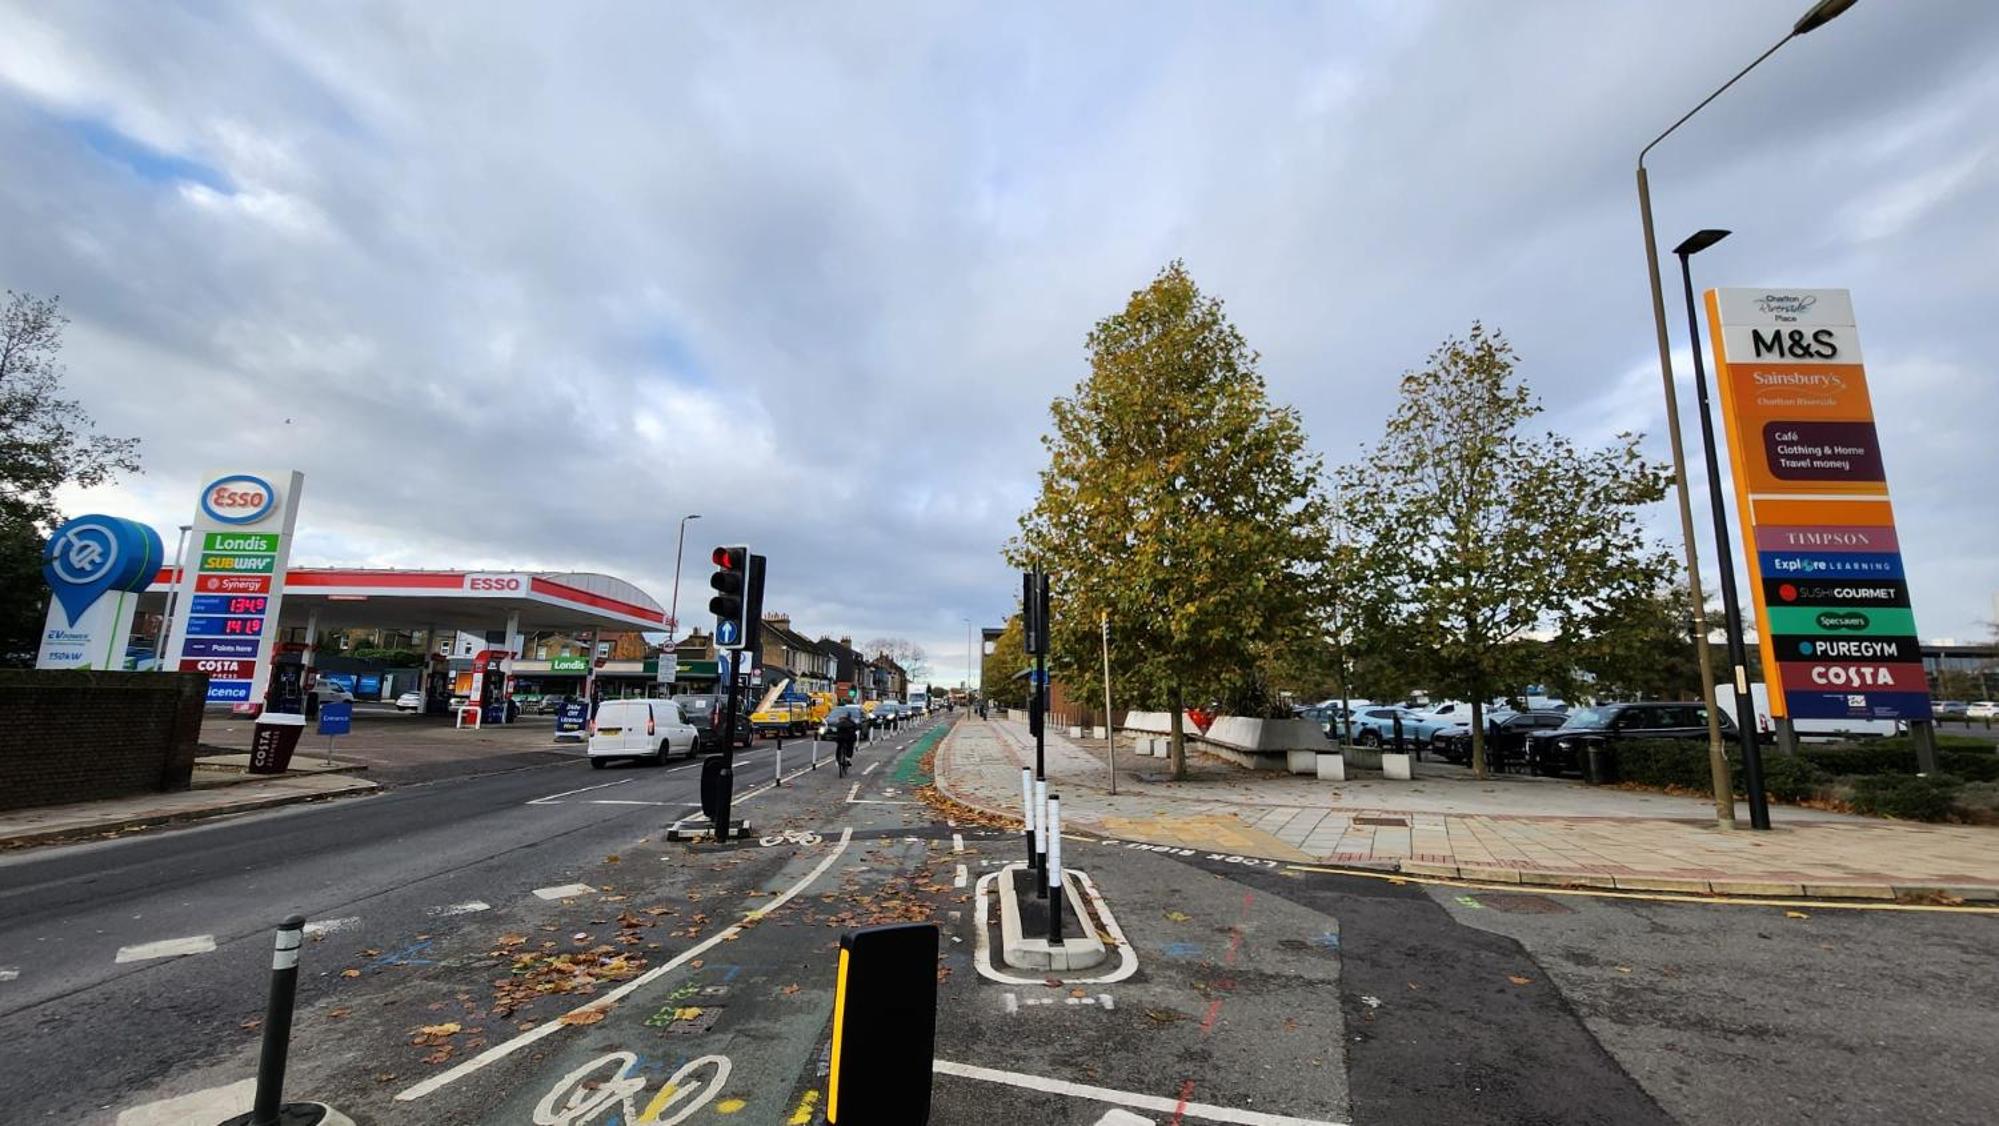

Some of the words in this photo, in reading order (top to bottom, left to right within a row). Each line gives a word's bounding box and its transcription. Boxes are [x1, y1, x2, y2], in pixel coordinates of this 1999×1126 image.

[1751, 329, 1838, 359] M&S
[1753, 371, 1841, 388] Sainsbury's
[1775, 432, 1799, 441] Café
[1777, 445, 1822, 456] Clothing
[1823, 446, 1832, 455] &
[1834, 446, 1865, 455] Home
[1780, 459, 1811, 468] Travel
[1813, 461, 1850, 471] money
[215, 536, 267, 550] Londis
[1787, 532, 1869, 545] TIMPSON
[205, 557, 271, 569] SUBWAY
[1829, 562, 1891, 570] LEARNING
[221, 580, 262, 591] Synergy
[469, 578, 520, 590] ESSO
[1820, 616, 1865, 627] Specsavers
[212, 644, 234, 653] Points
[235, 645, 252, 653] here
[1815, 641, 1898, 656] PUREGYM
[197, 661, 239, 672] COSTA
[554, 660, 585, 670] Londis
[1811, 666, 1895, 687] COSTA
[208, 686, 246, 697] icence
[255, 731, 272, 767] COSTA
[1205, 853, 1278, 868] LOOK
